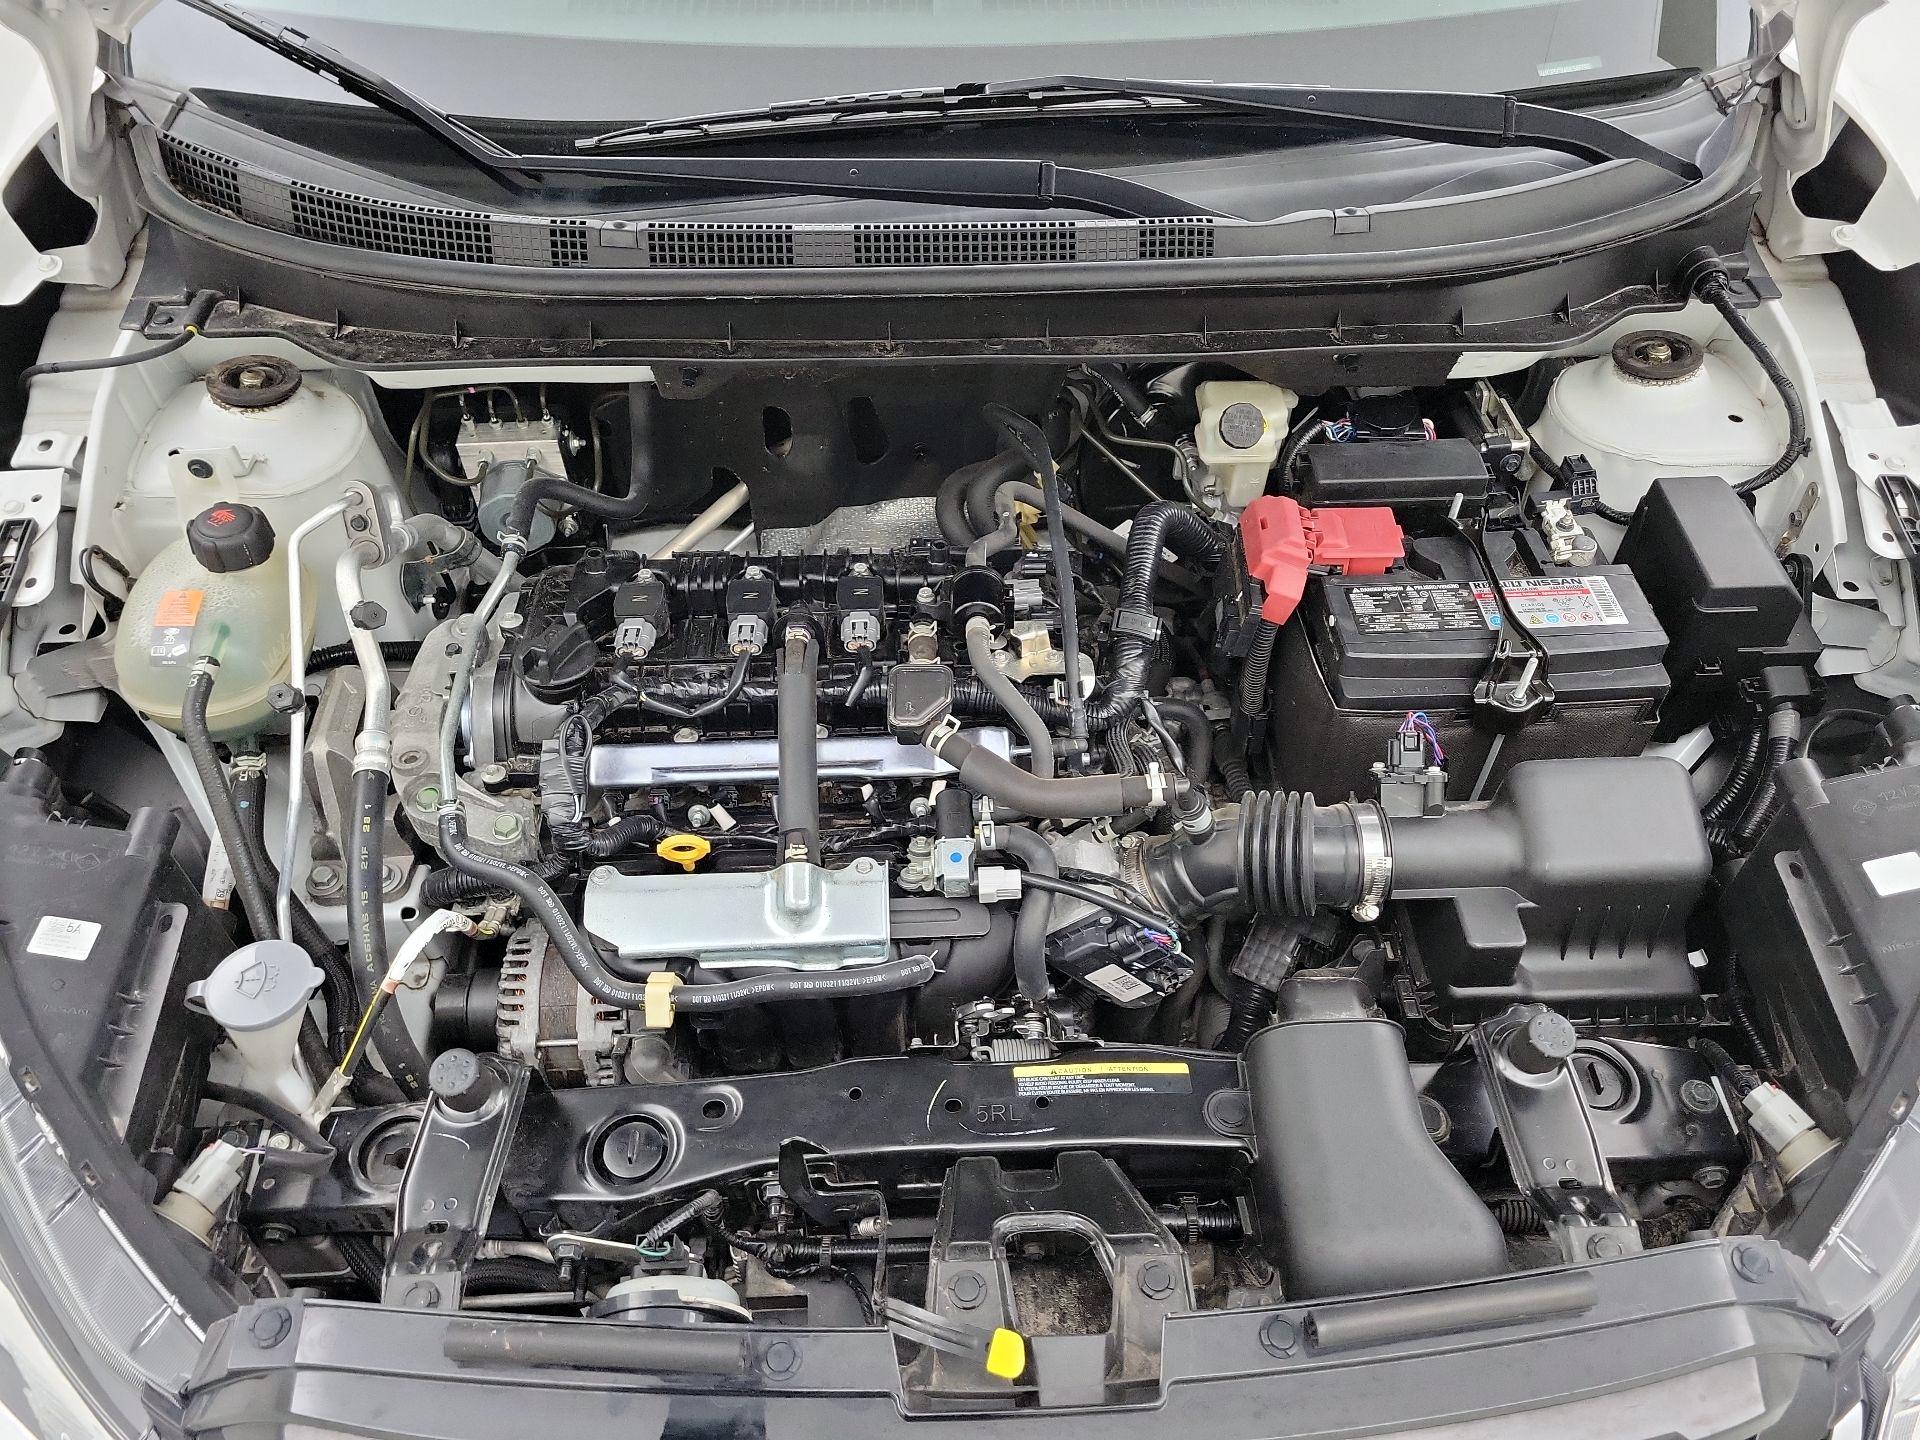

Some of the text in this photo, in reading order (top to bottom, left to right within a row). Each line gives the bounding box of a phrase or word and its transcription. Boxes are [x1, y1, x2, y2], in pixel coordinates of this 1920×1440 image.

[1472, 578, 1583, 590] REULT NISSAN
[537, 886, 549, 898] DOT
[790, 981, 801, 990] DOT
[976, 1104, 1022, 1122] 5RL
